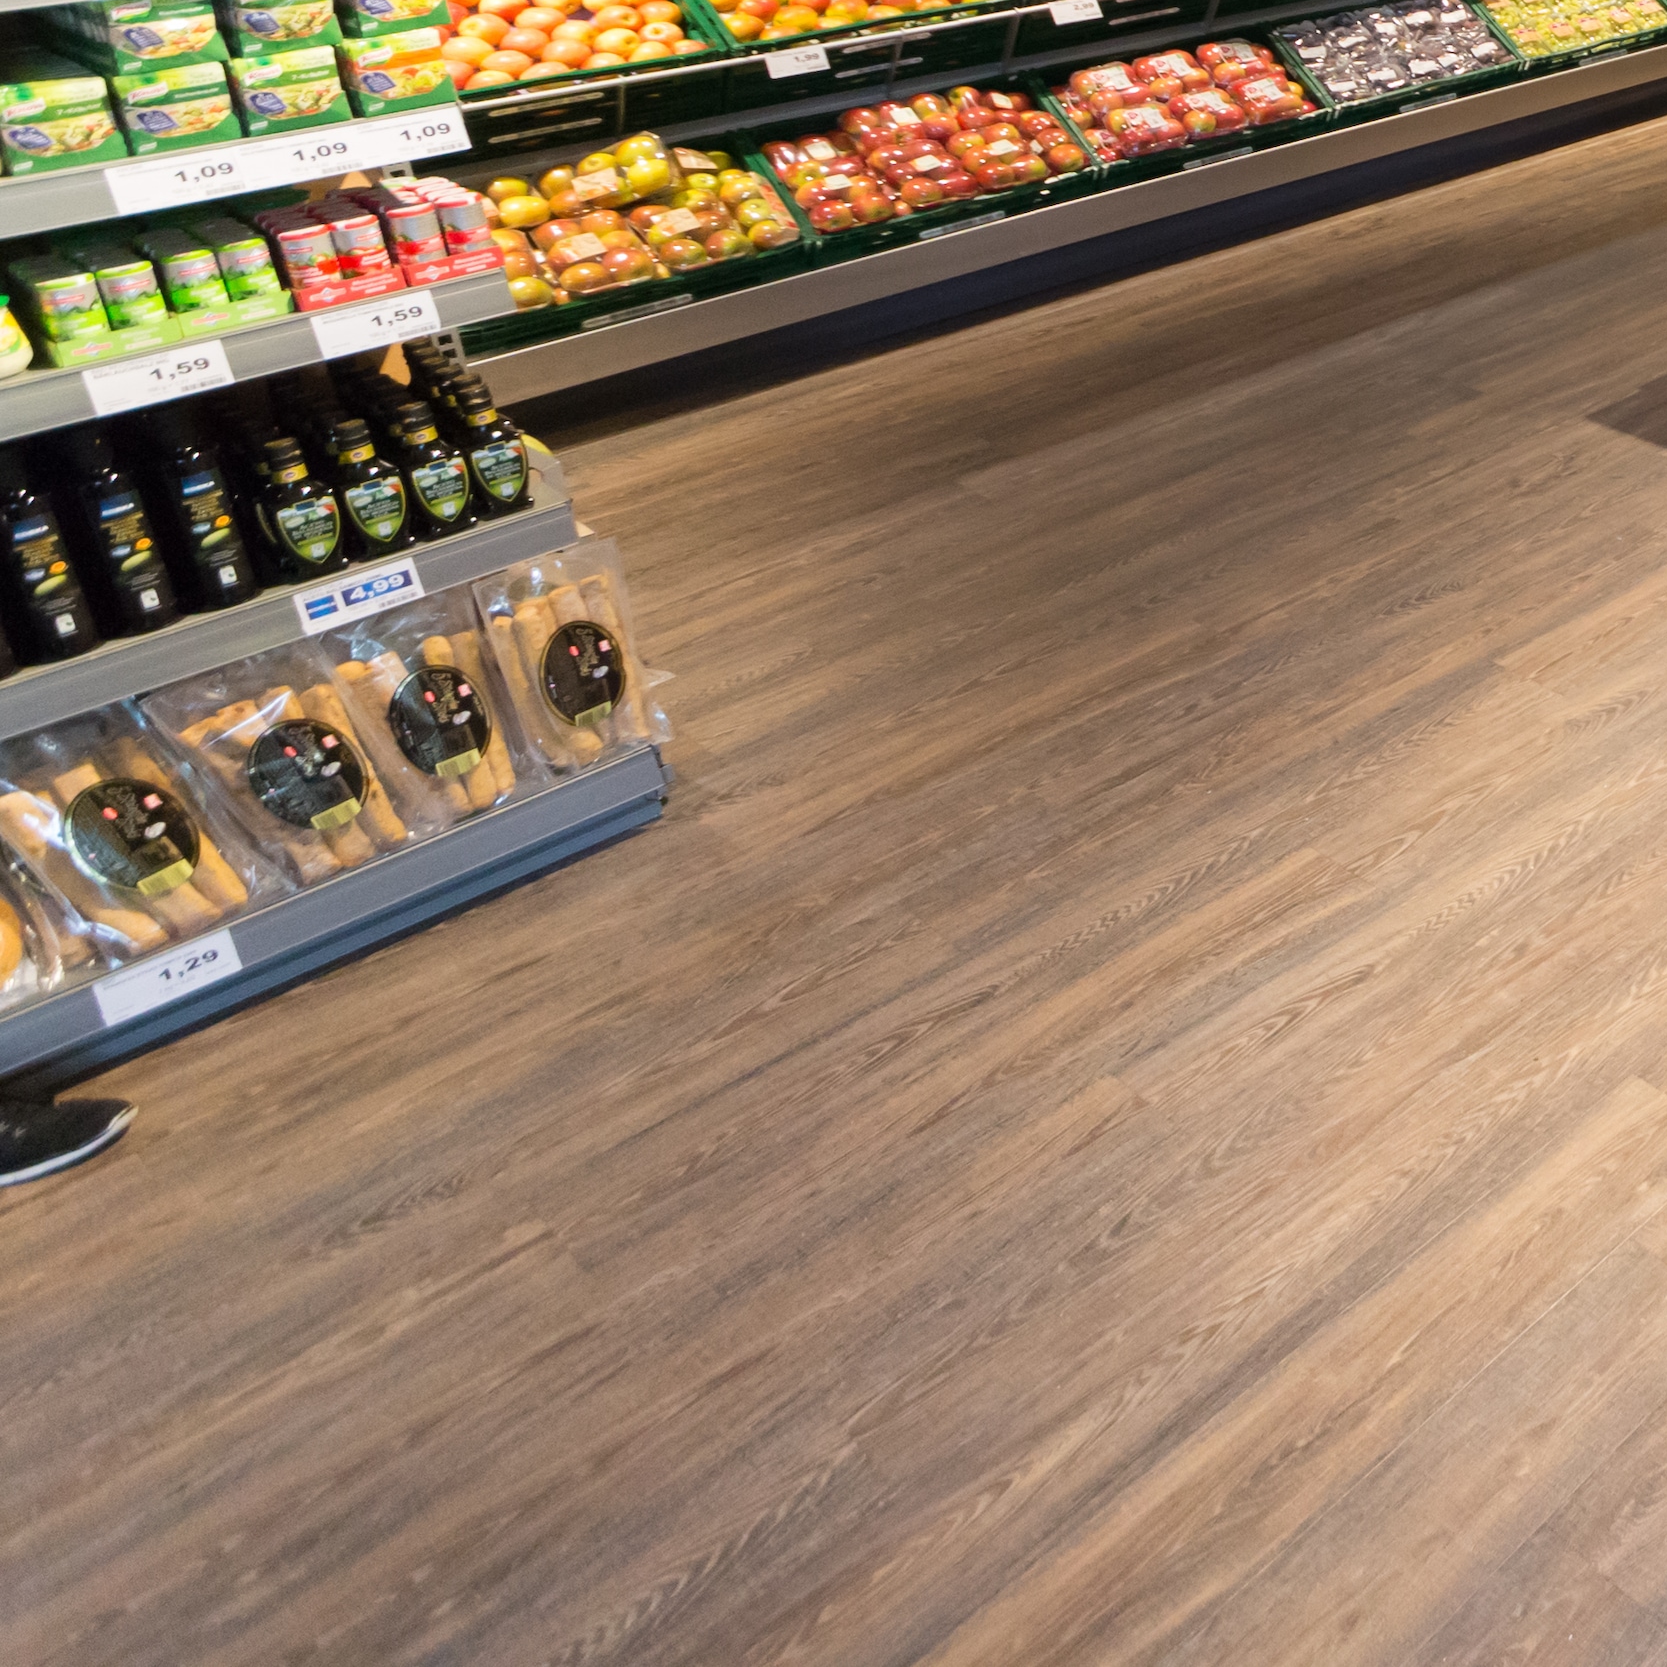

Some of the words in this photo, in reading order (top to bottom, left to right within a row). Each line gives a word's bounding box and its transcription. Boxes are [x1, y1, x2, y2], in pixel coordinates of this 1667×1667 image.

[400, 122, 451, 142] 1,09
[293, 141, 348, 162] 1,09
[174, 161, 234, 183] 1,09
[371, 306, 423, 327] 1,59
[150, 357, 210, 381] 1,59
[348, 574, 405, 603] 4,99
[158, 948, 219, 981] 1,29
